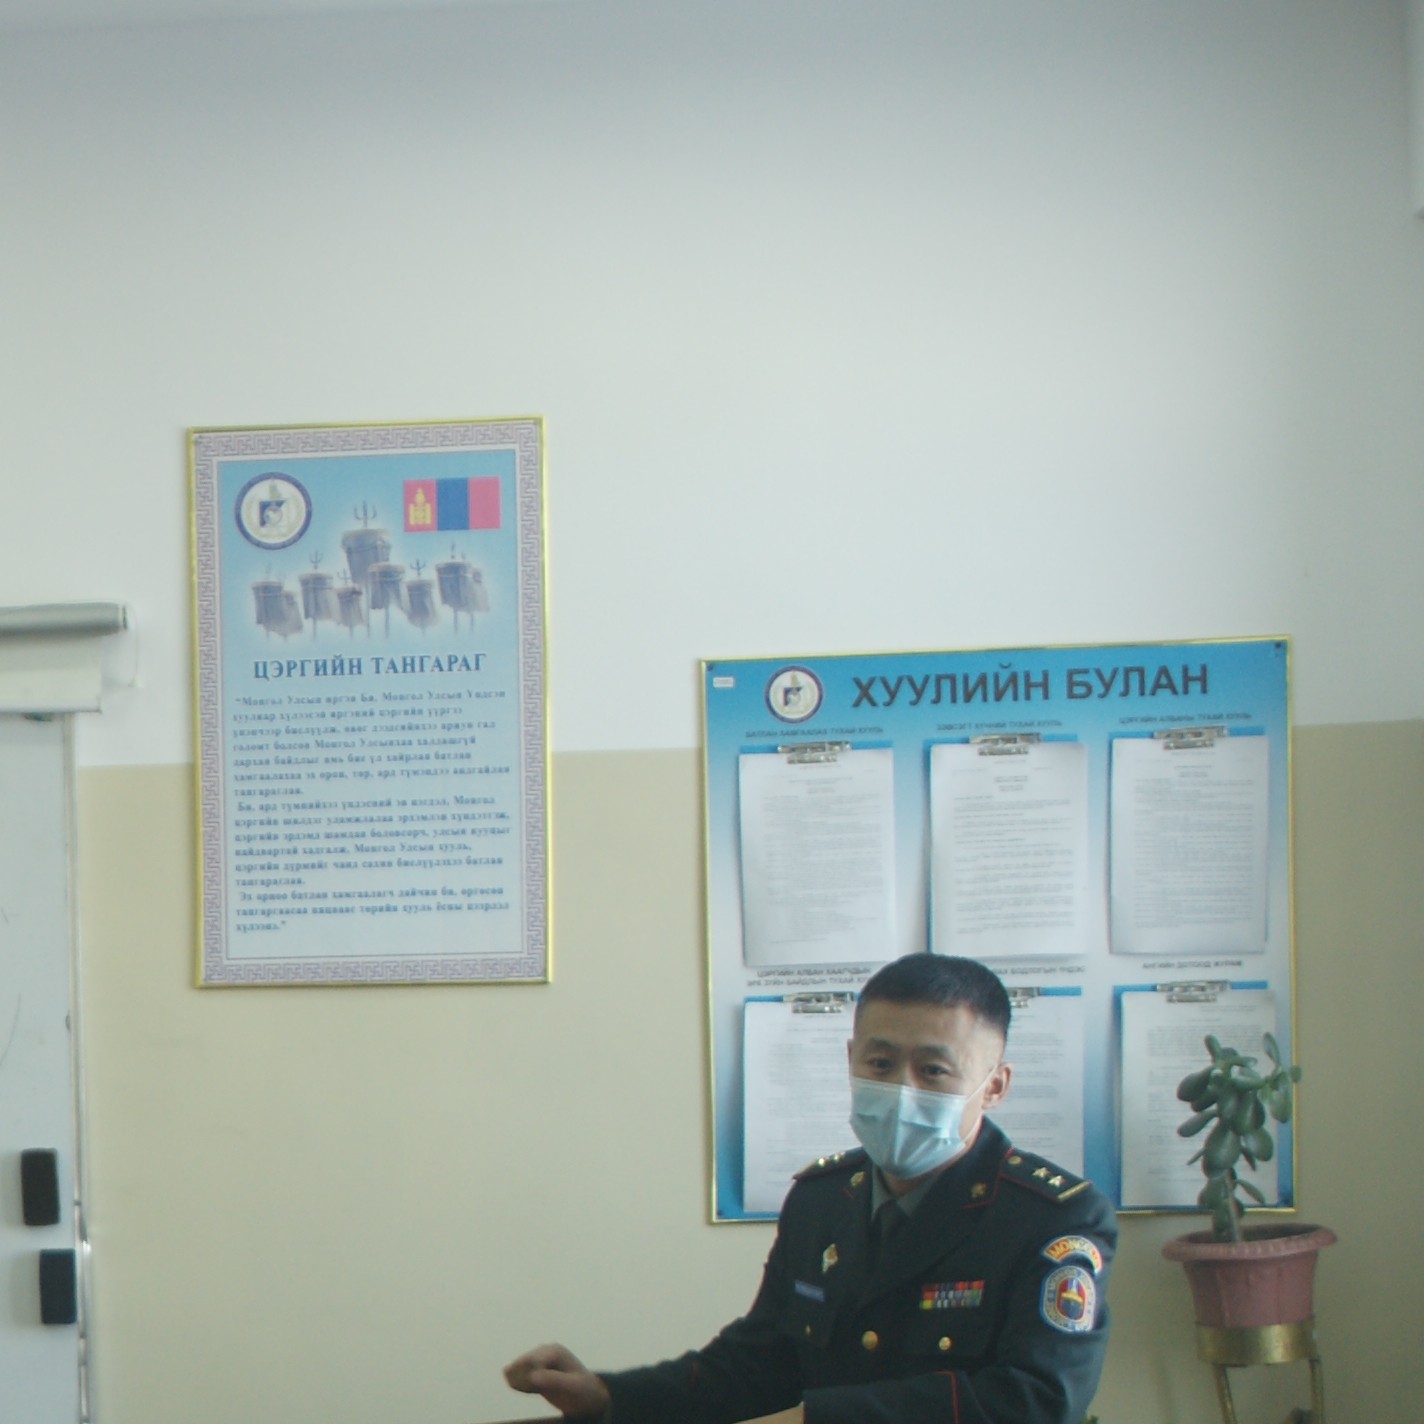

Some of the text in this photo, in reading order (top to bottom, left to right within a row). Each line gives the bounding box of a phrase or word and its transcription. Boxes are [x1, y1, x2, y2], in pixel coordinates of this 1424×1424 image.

[253, 653, 487, 681] ЦЭРГИЙН ТАНГАРАГ
[851, 662, 1208, 708] ХУУЛИЙН БУЛАН
